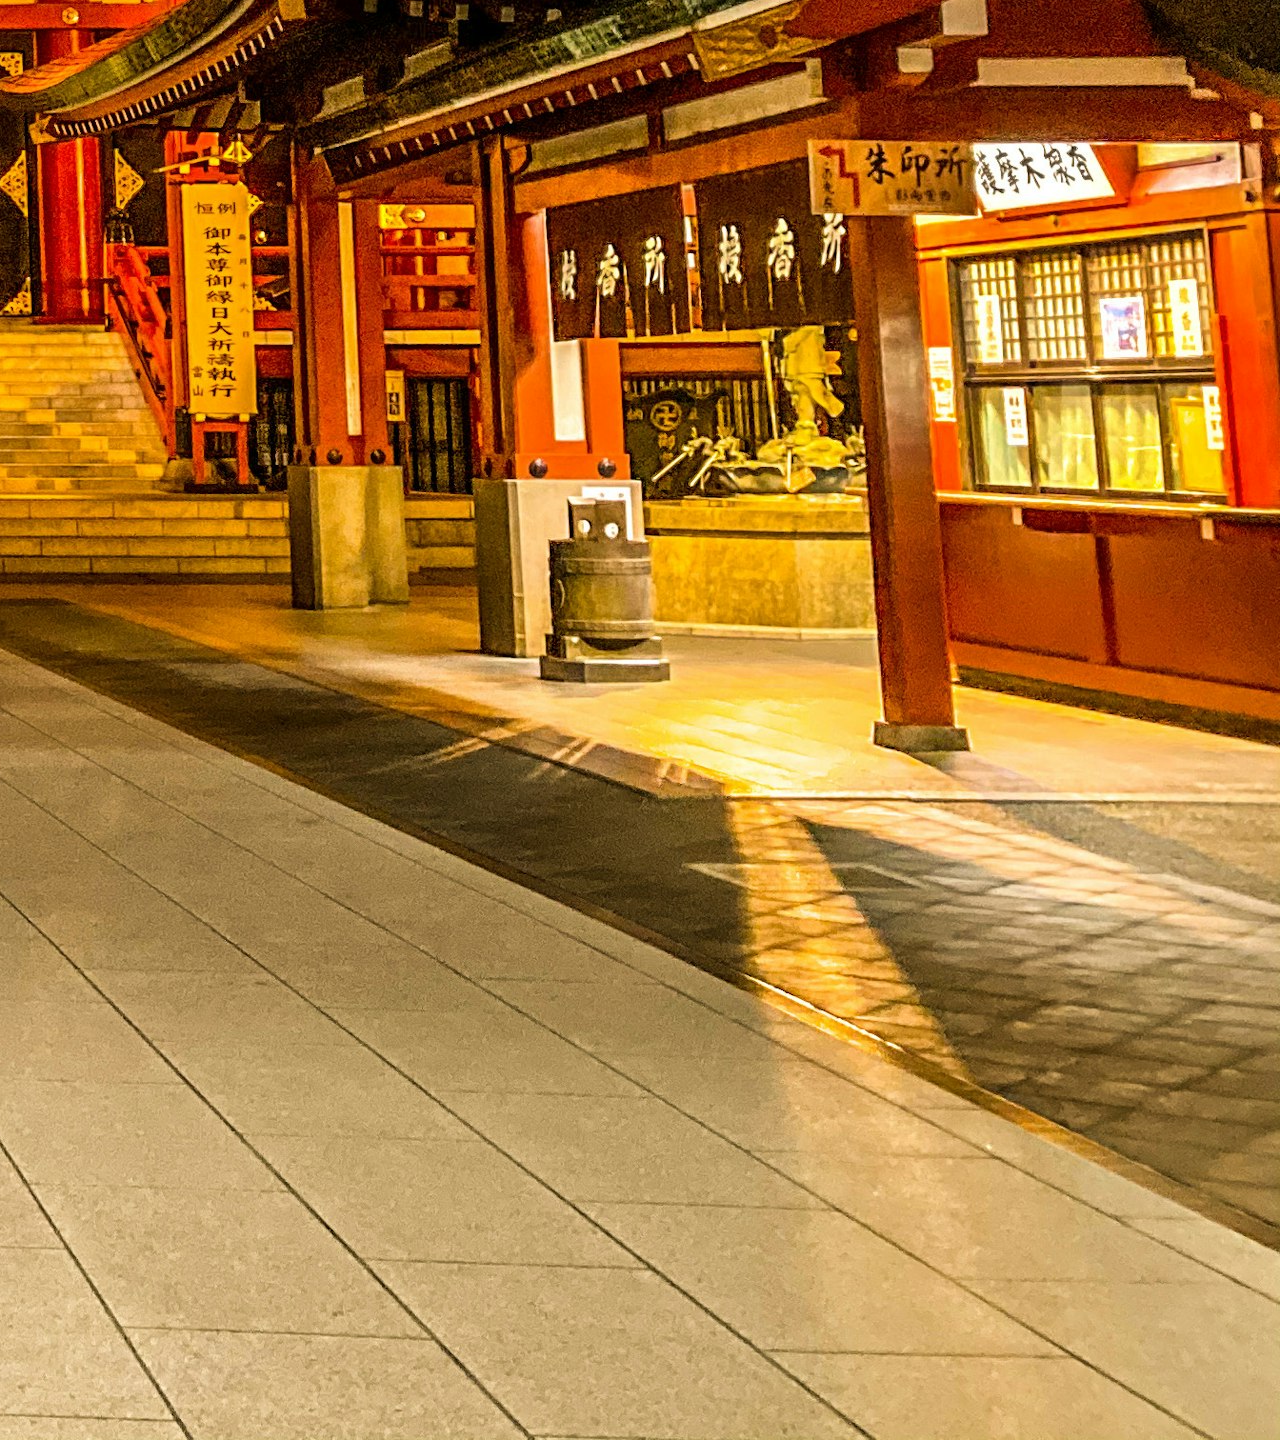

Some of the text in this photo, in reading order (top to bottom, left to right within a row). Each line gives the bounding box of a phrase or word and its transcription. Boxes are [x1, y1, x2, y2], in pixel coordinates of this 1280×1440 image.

[866, 143, 967, 187] 朱印所
[194, 202, 236, 214] 恒例
